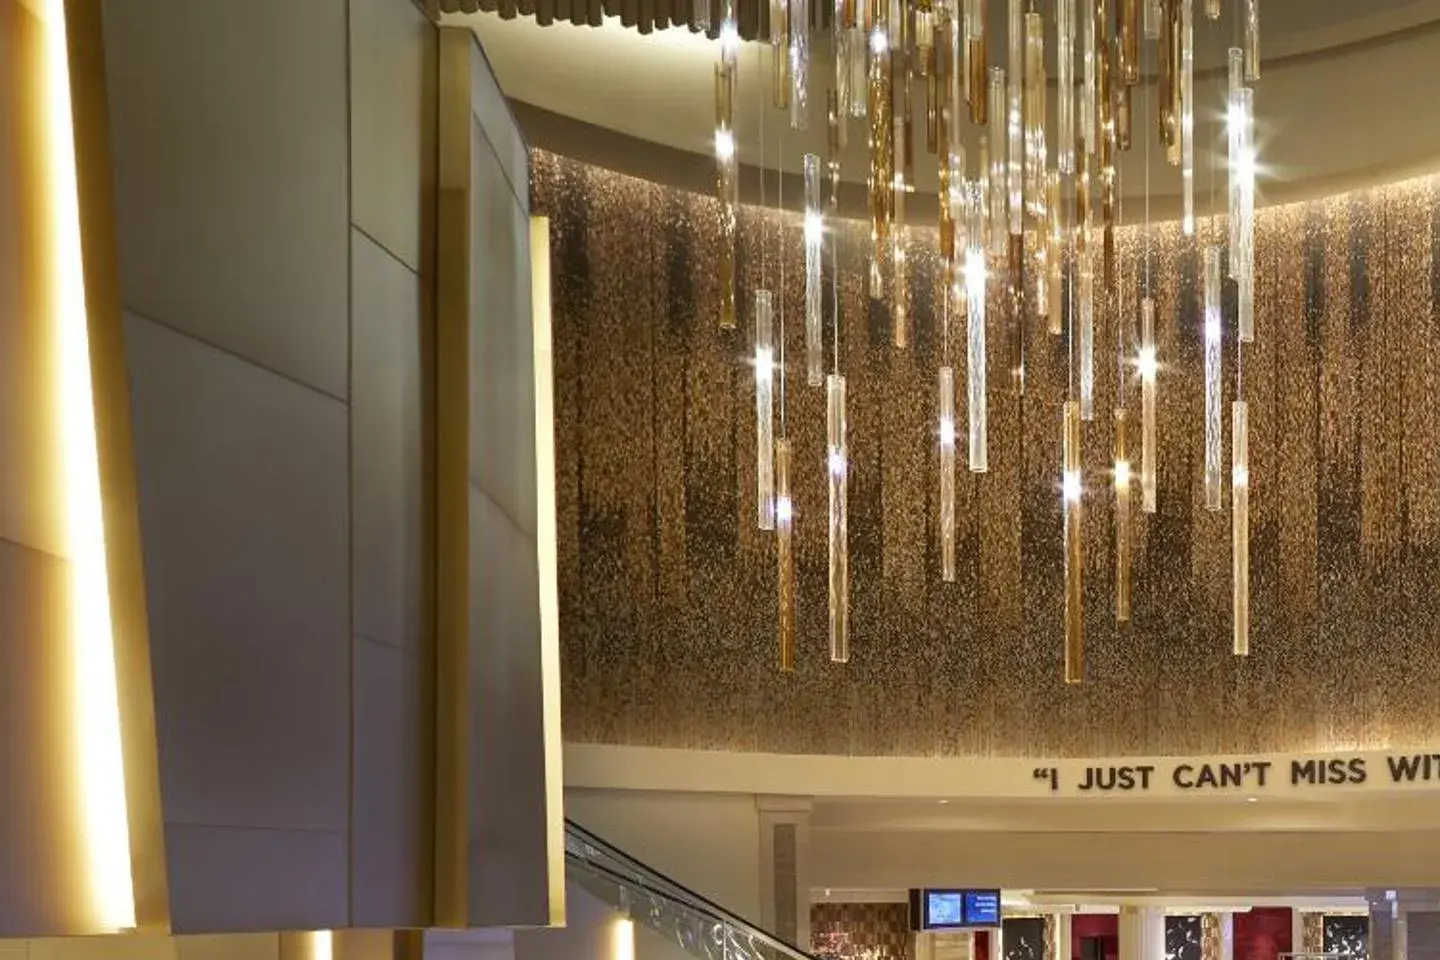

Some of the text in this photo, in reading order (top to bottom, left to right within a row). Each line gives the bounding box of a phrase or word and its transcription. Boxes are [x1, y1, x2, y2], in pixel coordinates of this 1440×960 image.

[1078, 765, 1154, 790] JUST
[1172, 761, 1272, 788] CAN’T
[1290, 757, 1367, 785] MISS
